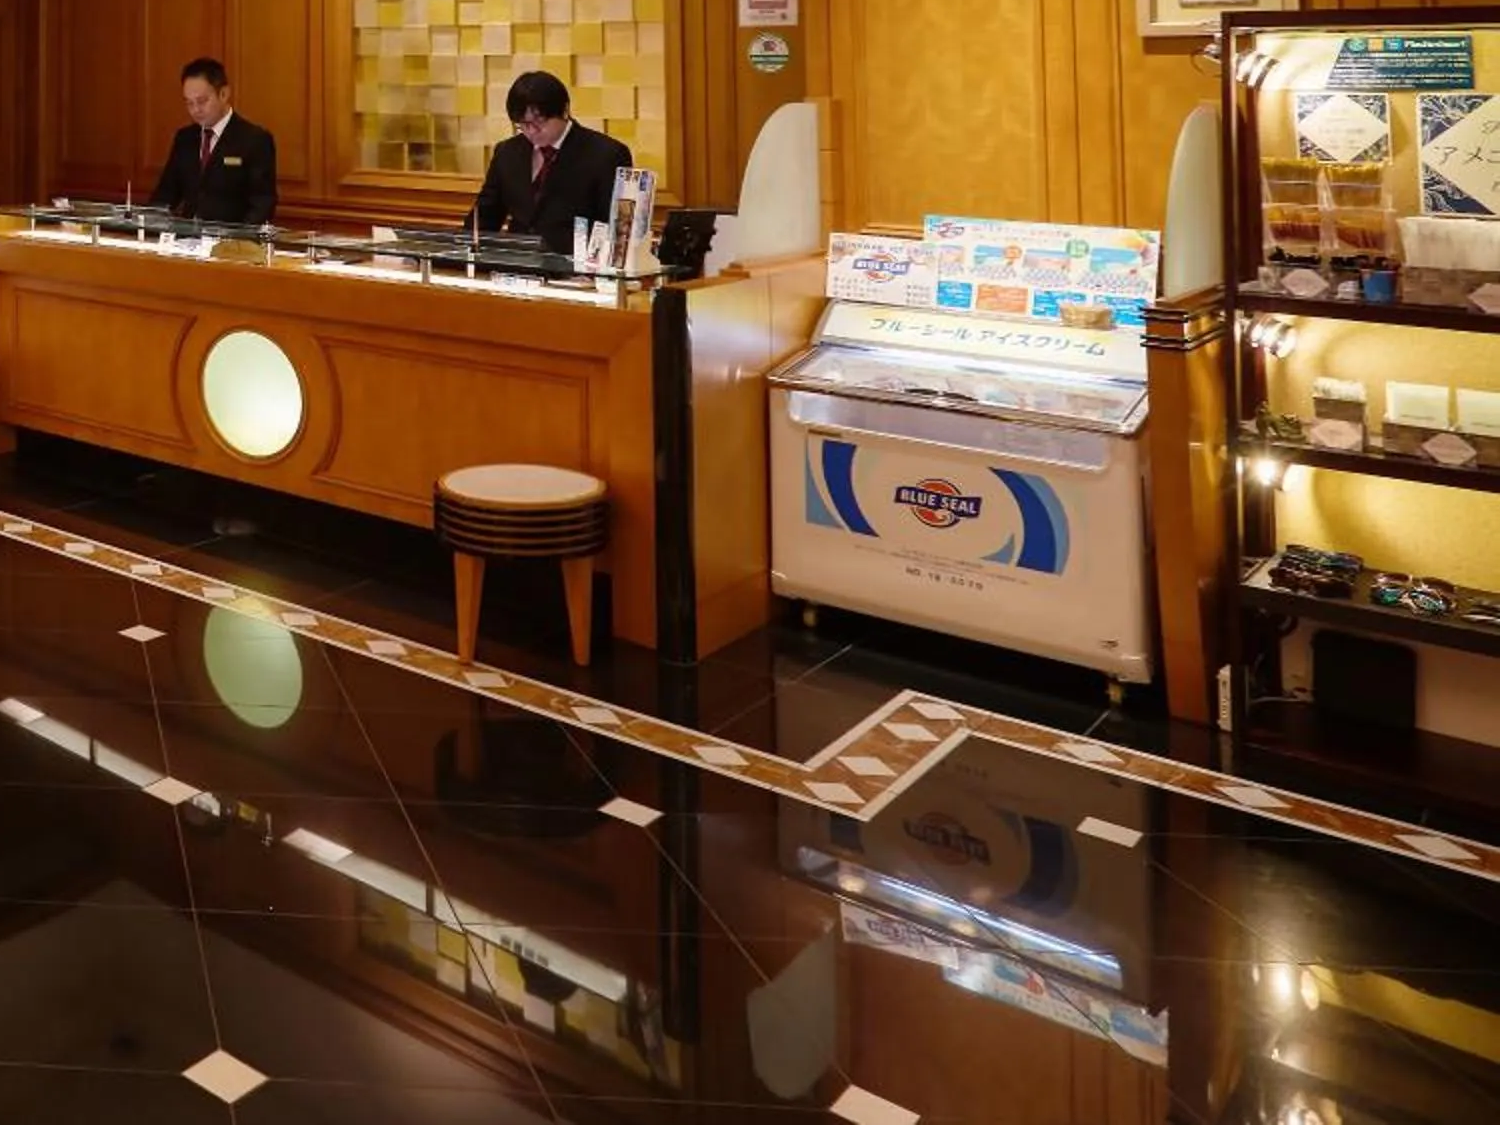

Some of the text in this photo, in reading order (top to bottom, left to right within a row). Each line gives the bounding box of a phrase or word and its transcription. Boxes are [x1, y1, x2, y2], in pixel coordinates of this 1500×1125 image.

[980, 329, 1106, 356] アイスクリーム
[900, 490, 978, 514] BLUE SEAL
